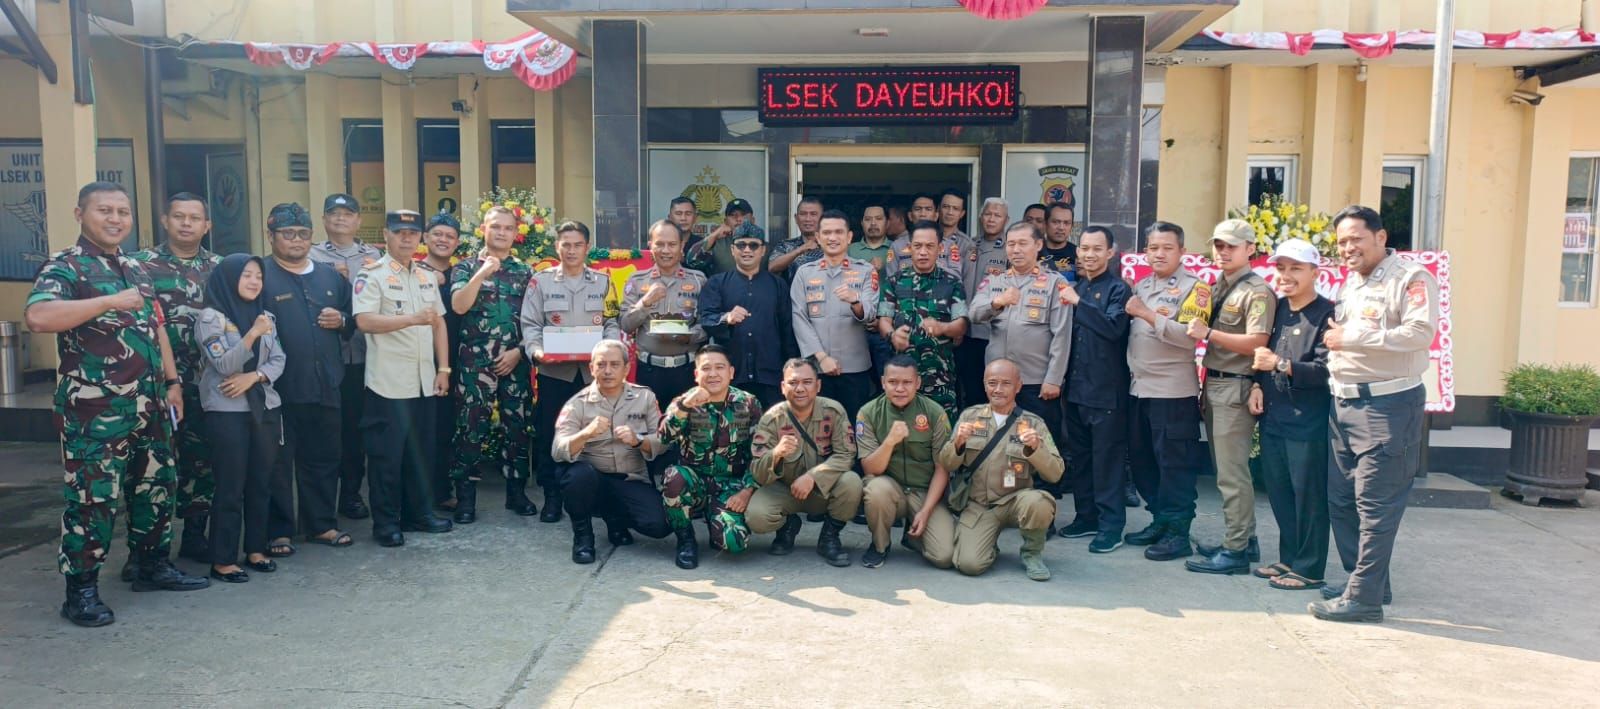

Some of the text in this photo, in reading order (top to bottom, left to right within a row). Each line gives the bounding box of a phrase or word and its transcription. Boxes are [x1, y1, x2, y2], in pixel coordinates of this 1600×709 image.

[767, 82, 1014, 108] LSEK DAYEUHKOL
[12, 153, 41, 167] UNIT
[1, 169, 31, 183] LSEK
